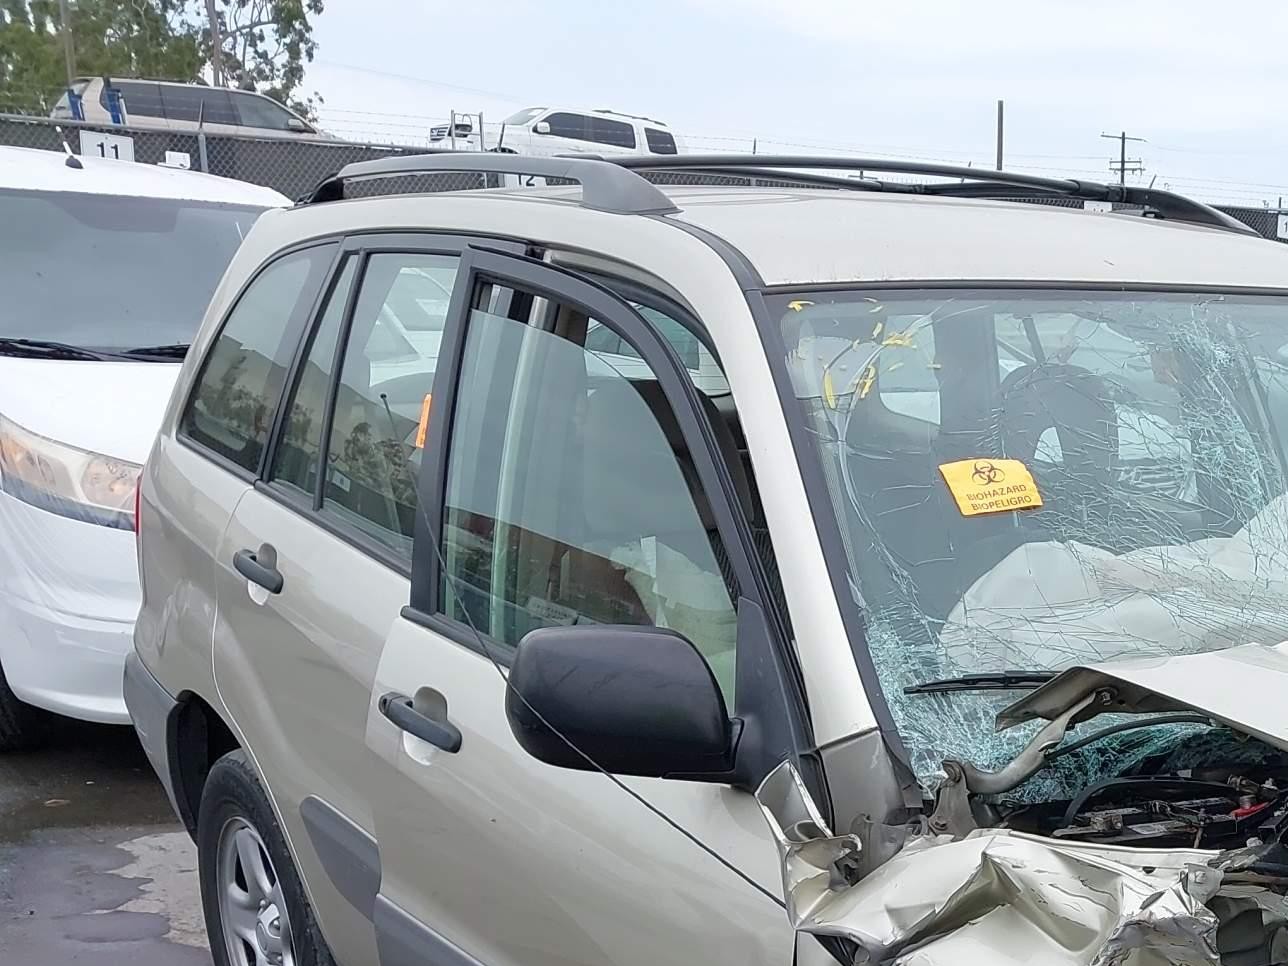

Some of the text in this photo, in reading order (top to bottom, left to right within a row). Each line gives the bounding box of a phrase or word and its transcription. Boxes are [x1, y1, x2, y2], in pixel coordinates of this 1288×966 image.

[97, 142, 119, 159] 11
[966, 484, 1027, 501] BIOHAZARD
[971, 495, 1032, 511] BIOPELIGRO
